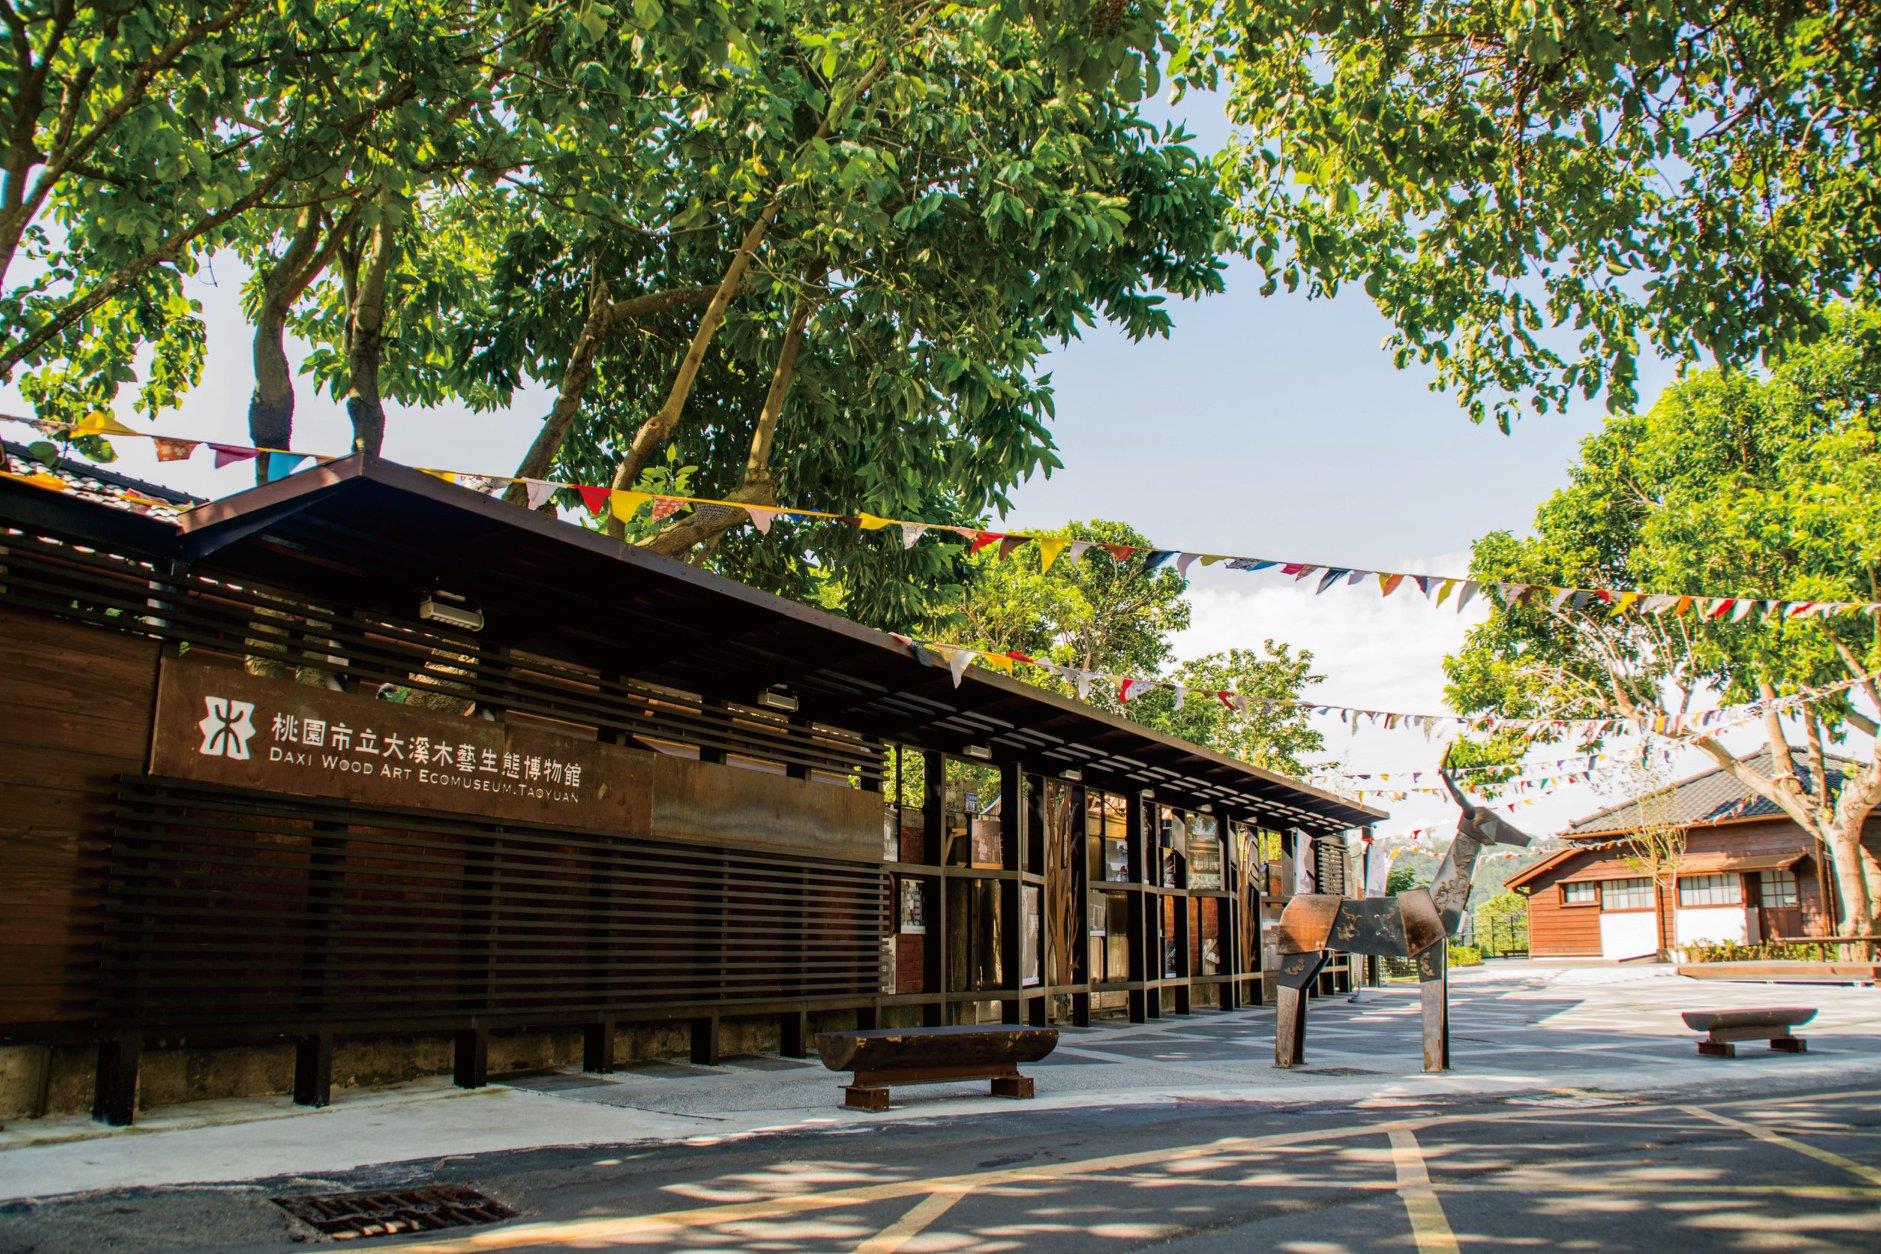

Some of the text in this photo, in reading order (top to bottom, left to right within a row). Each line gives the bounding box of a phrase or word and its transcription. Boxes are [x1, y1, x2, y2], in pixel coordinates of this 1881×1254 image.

[269, 747, 312, 767] DAXI
[321, 754, 374, 775] WOOD
[379, 763, 413, 781] ART
[271, 711, 582, 788] 桃園市立大溪木藝生態博物館
